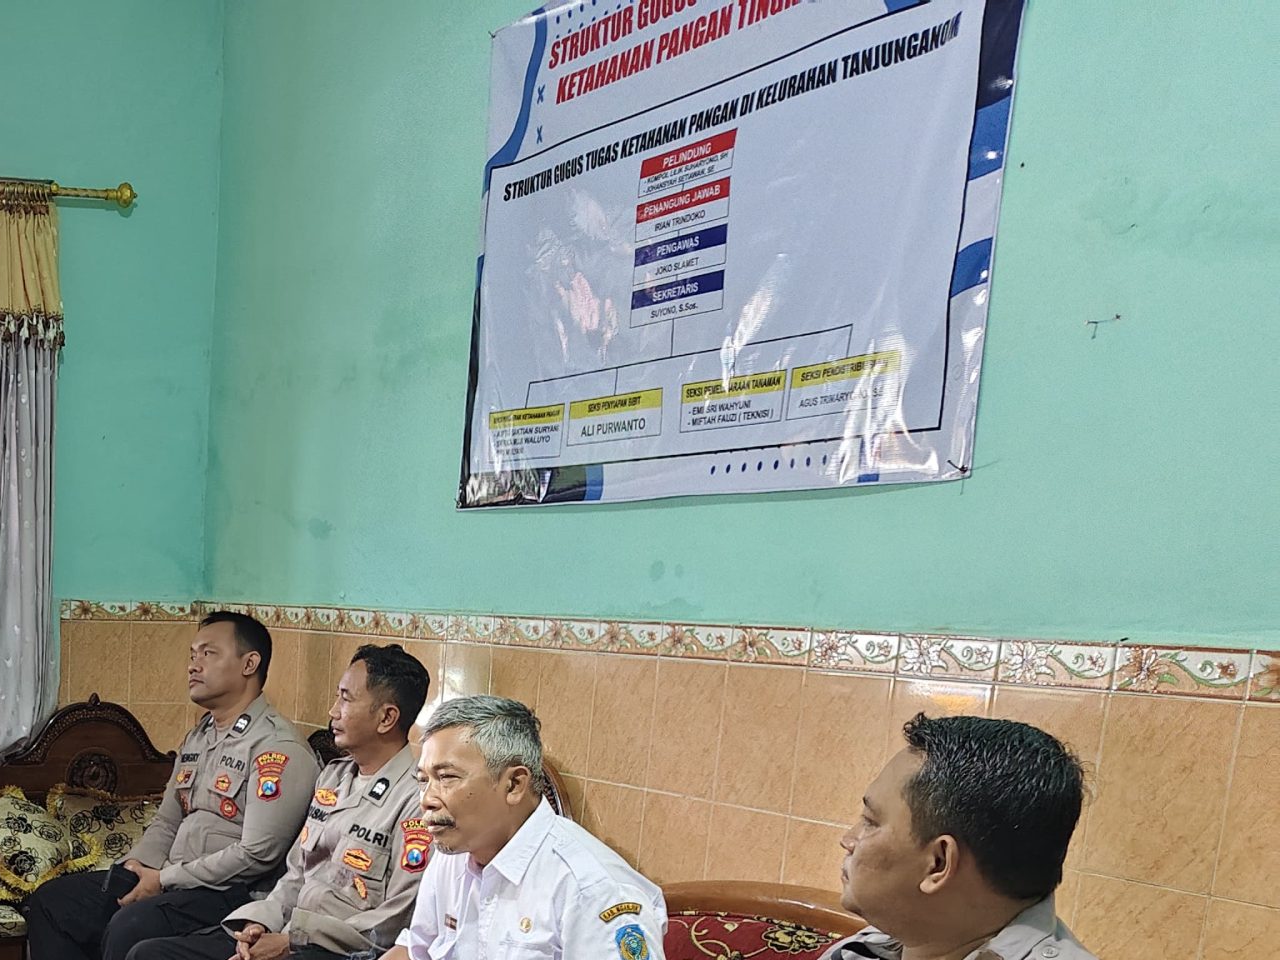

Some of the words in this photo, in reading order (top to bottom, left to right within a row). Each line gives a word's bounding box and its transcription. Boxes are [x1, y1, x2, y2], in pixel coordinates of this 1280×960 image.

[548, 6, 634, 69] STRUKTUR
[556, 39, 655, 104] KETAHANAN
[656, 4, 734, 64] PANGAN
[503, 168, 552, 202] STRUKTUR
[554, 157, 584, 186] GUGUS
[585, 142, 619, 171] TUGAS
[620, 117, 688, 159] KETAHANAN
[688, 99, 740, 136] PANGAN
[740, 90, 756, 117] DI
[756, 58, 839, 111] KELURAHAN
[841, 11, 963, 80] TANJUNGANOM
[662, 142, 712, 169] PELINDUNG
[643, 193, 691, 217] PENANGUNG
[691, 184, 721, 202] JAWAB
[655, 235, 700, 256] PENGAWAS
[655, 263, 672, 276] JOKO
[673, 256, 699, 272] SLAMET
[652, 281, 699, 302] SEKRETARIS
[650, 305, 678, 319] SUYONO,
[801, 370, 822, 381] SEKSI
[686, 387, 702, 398] SEKSI
[751, 376, 782, 389] TANAMAN
[706, 404, 717, 413] SRI
[719, 400, 752, 412] WAHYUNI
[799, 396, 819, 408] AGUS
[581, 426, 595, 437] ALI
[597, 418, 646, 435] PURWANTO
[691, 416, 716, 426] MIFTAH
[220, 755, 246, 772] POLRI
[348, 823, 389, 848] POLRI
